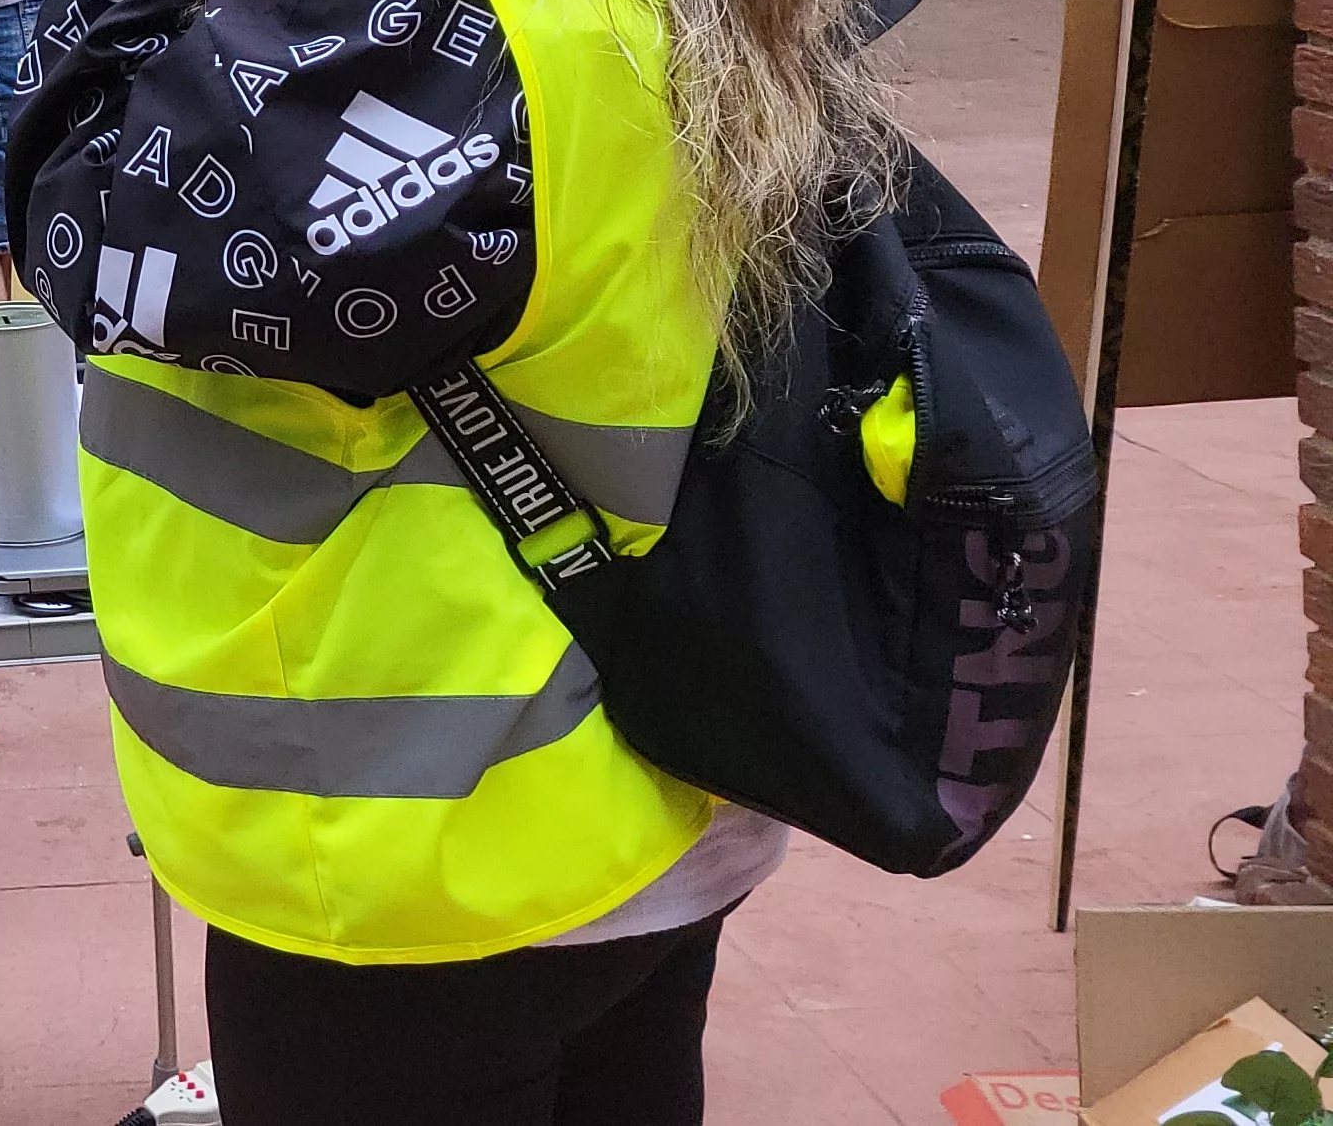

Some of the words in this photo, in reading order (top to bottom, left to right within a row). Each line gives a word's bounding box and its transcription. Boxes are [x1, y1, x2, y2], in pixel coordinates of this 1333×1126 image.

[305, 132, 501, 257] adidas
[428, 371, 509, 454] LOVE
[483, 445, 563, 532] TRUE
